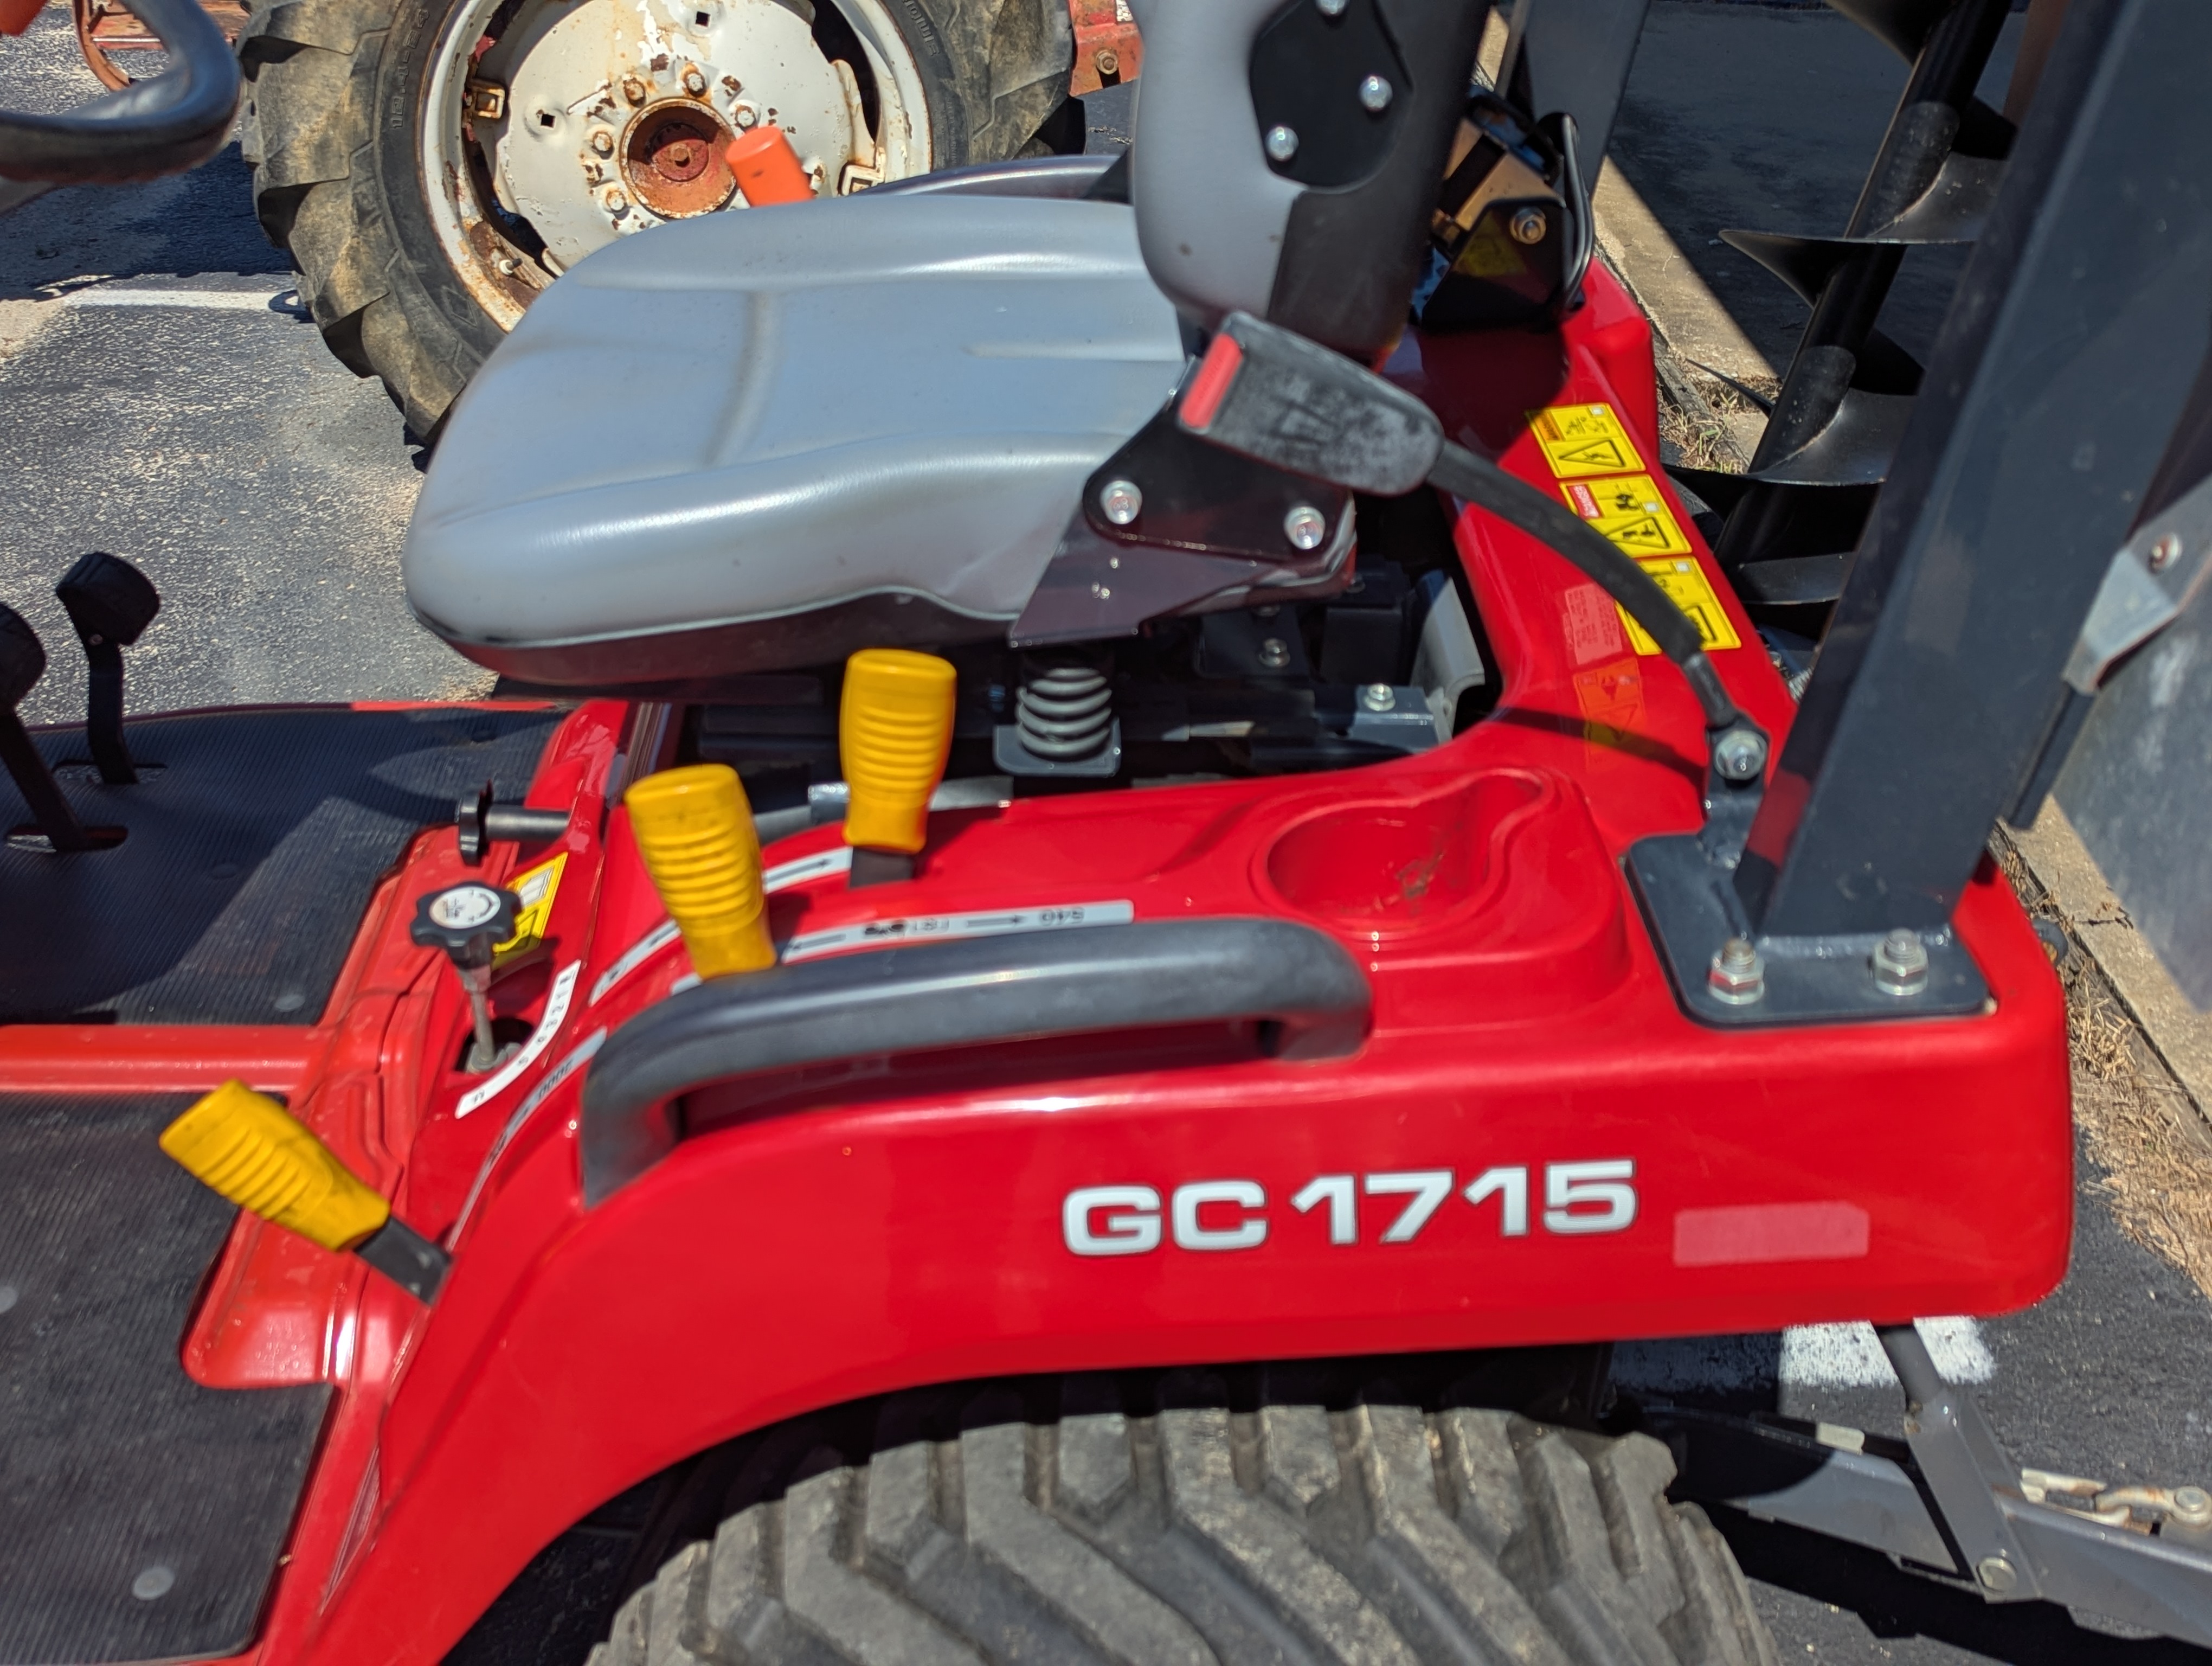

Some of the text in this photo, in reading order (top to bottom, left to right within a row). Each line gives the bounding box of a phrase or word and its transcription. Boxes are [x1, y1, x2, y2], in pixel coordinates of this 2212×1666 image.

[389, 8, 430, 129] 12.4-24
[1062, 1158, 1637, 1257] GC 1715
